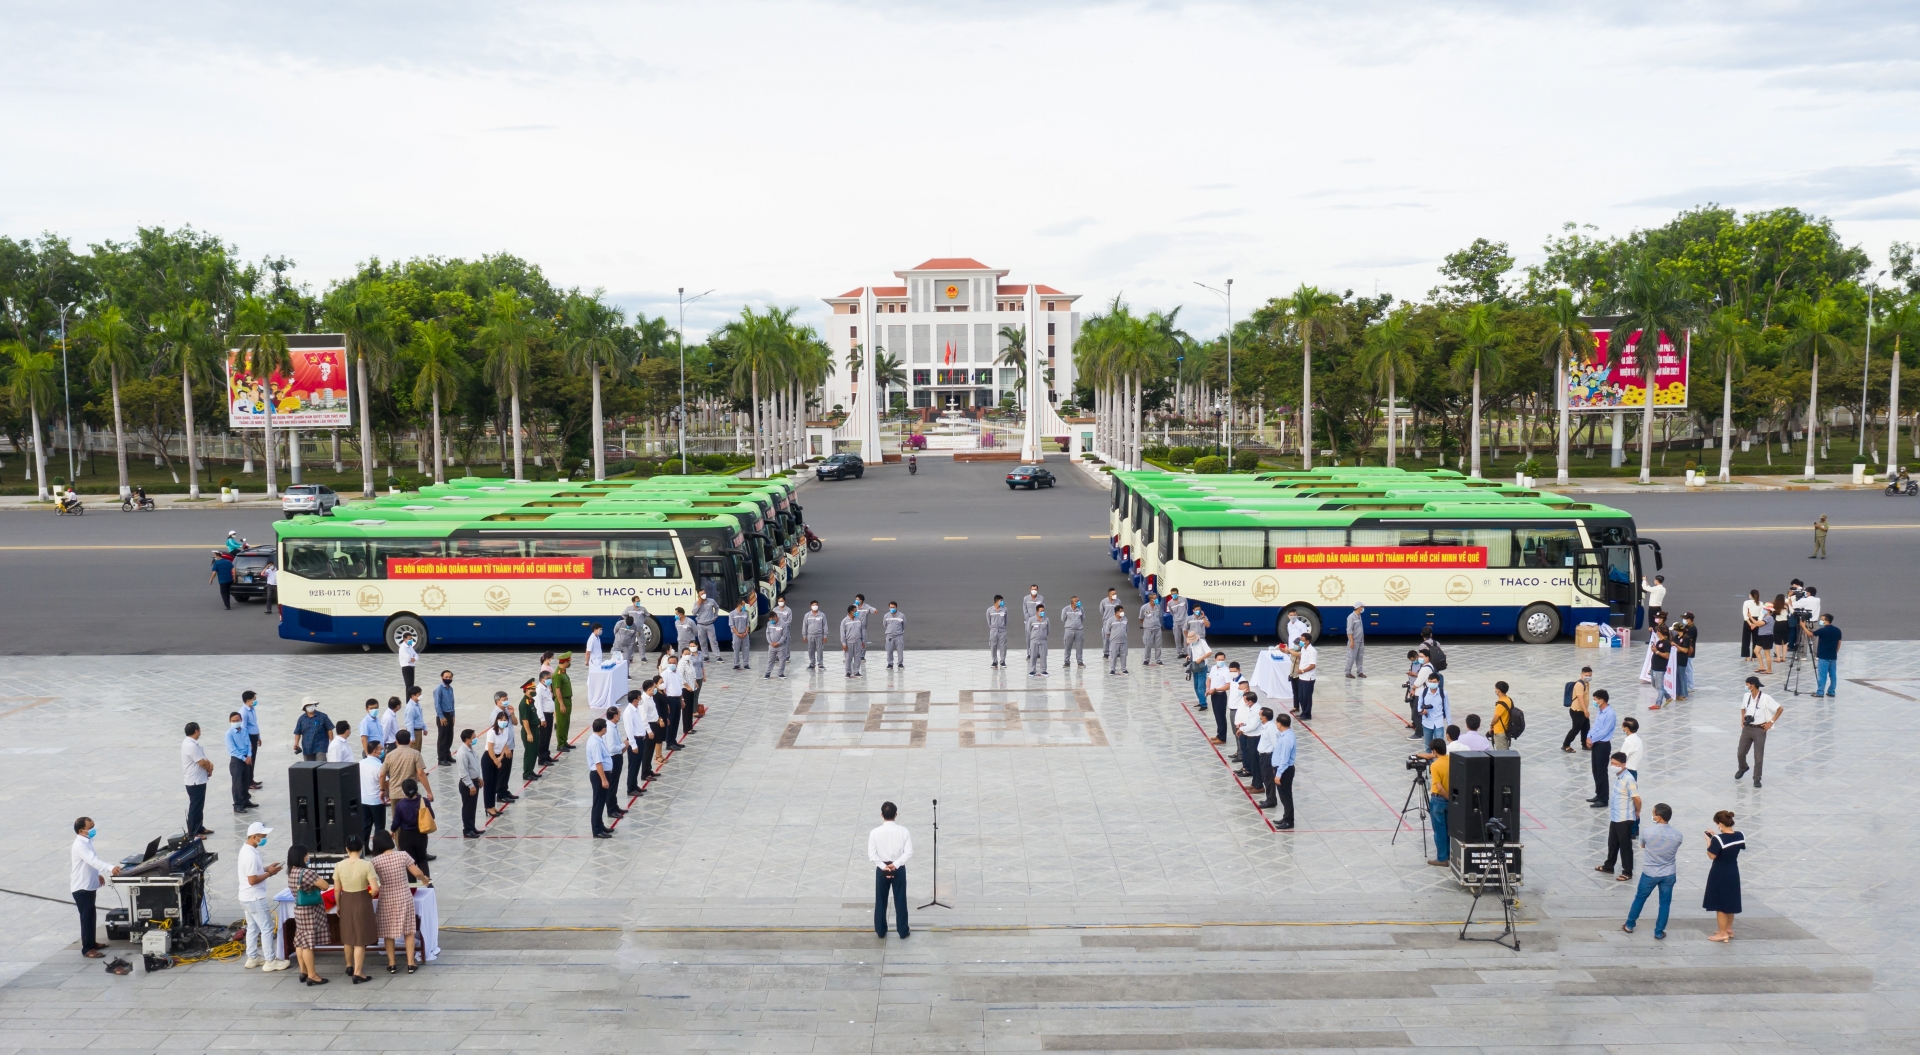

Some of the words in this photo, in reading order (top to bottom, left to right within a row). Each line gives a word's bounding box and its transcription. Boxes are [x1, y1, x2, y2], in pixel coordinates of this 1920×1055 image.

[1284, 554, 1292, 563] XE
[1293, 552, 1305, 563] ĐÓN
[1307, 552, 1325, 563] NGƯỜI
[1326, 552, 1338, 562] DÂN
[1340, 552, 1359, 563] QUẢNG
[1361, 554, 1374, 562] NAM
[1376, 552, 1384, 562] TỪ
[1385, 552, 1404, 562] THÀNH
[1406, 551, 1418, 562] PHỐ
[1420, 551, 1428, 562] HỒ
[1430, 552, 1440, 562] CHÍ
[1441, 554, 1457, 562] MINH
[1459, 551, 1466, 562] VỀ
[1468, 552, 1479, 563] QUÊ
[395, 565, 402, 573] XE
[403, 563, 415, 573] ĐÓN
[417, 563, 434, 573] NGƯỜI
[436, 563, 447, 573] DÂN
[448, 563, 468, 574] QUẢNG
[469, 565, 482, 573] NAM
[484, 563, 491, 573] TỪ
[492, 563, 511, 573] THÀNH
[513, 562, 525, 573] PHỐ
[526, 562, 534, 573] HỒ
[536, 563, 546, 573] CHÍ
[548, 565, 562, 573] MINH
[564, 562, 571, 573] VỀ
[573, 563, 585, 574] QUÊ
[1500, 578, 1540, 586] THACO
[1551, 578, 1574, 586] CHU
[1579, 578, 1597, 586] LAI
